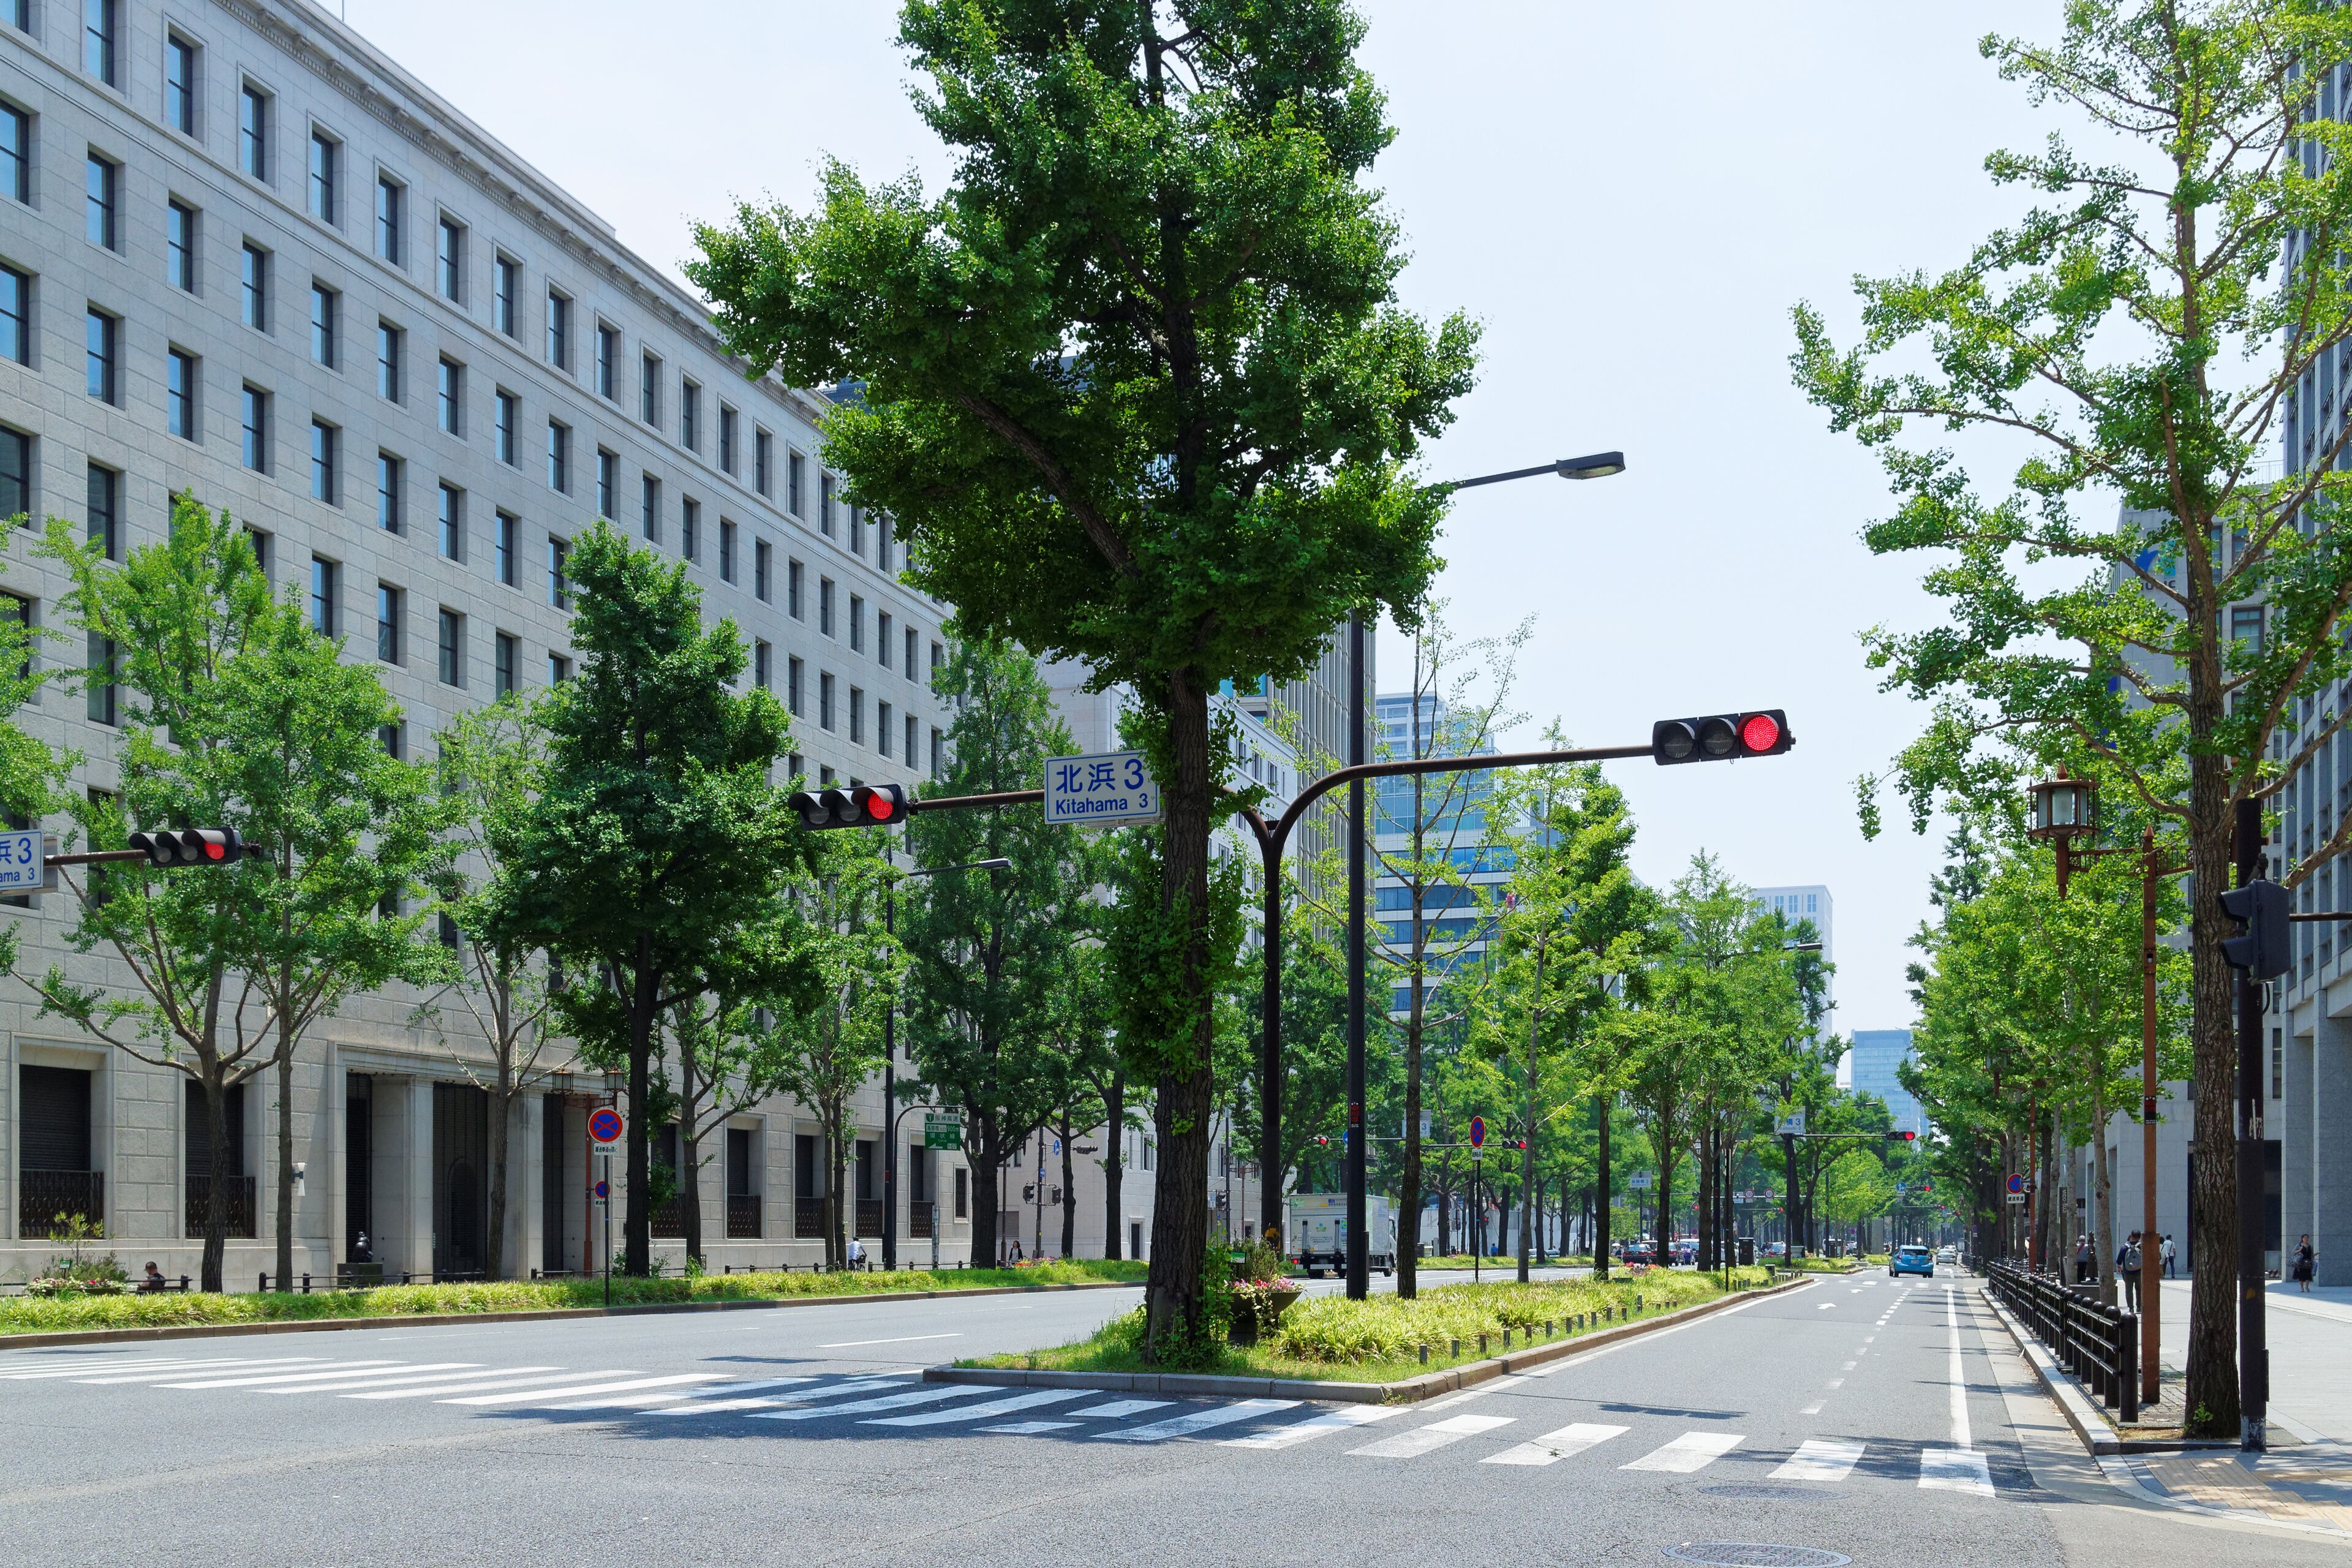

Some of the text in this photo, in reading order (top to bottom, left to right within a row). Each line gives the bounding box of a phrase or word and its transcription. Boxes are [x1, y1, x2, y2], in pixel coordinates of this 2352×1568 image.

[1056, 758, 1144, 794] 北浜3
[1056, 793, 1148, 815] Kitahama 3
[28, 867, 34, 880] 3
